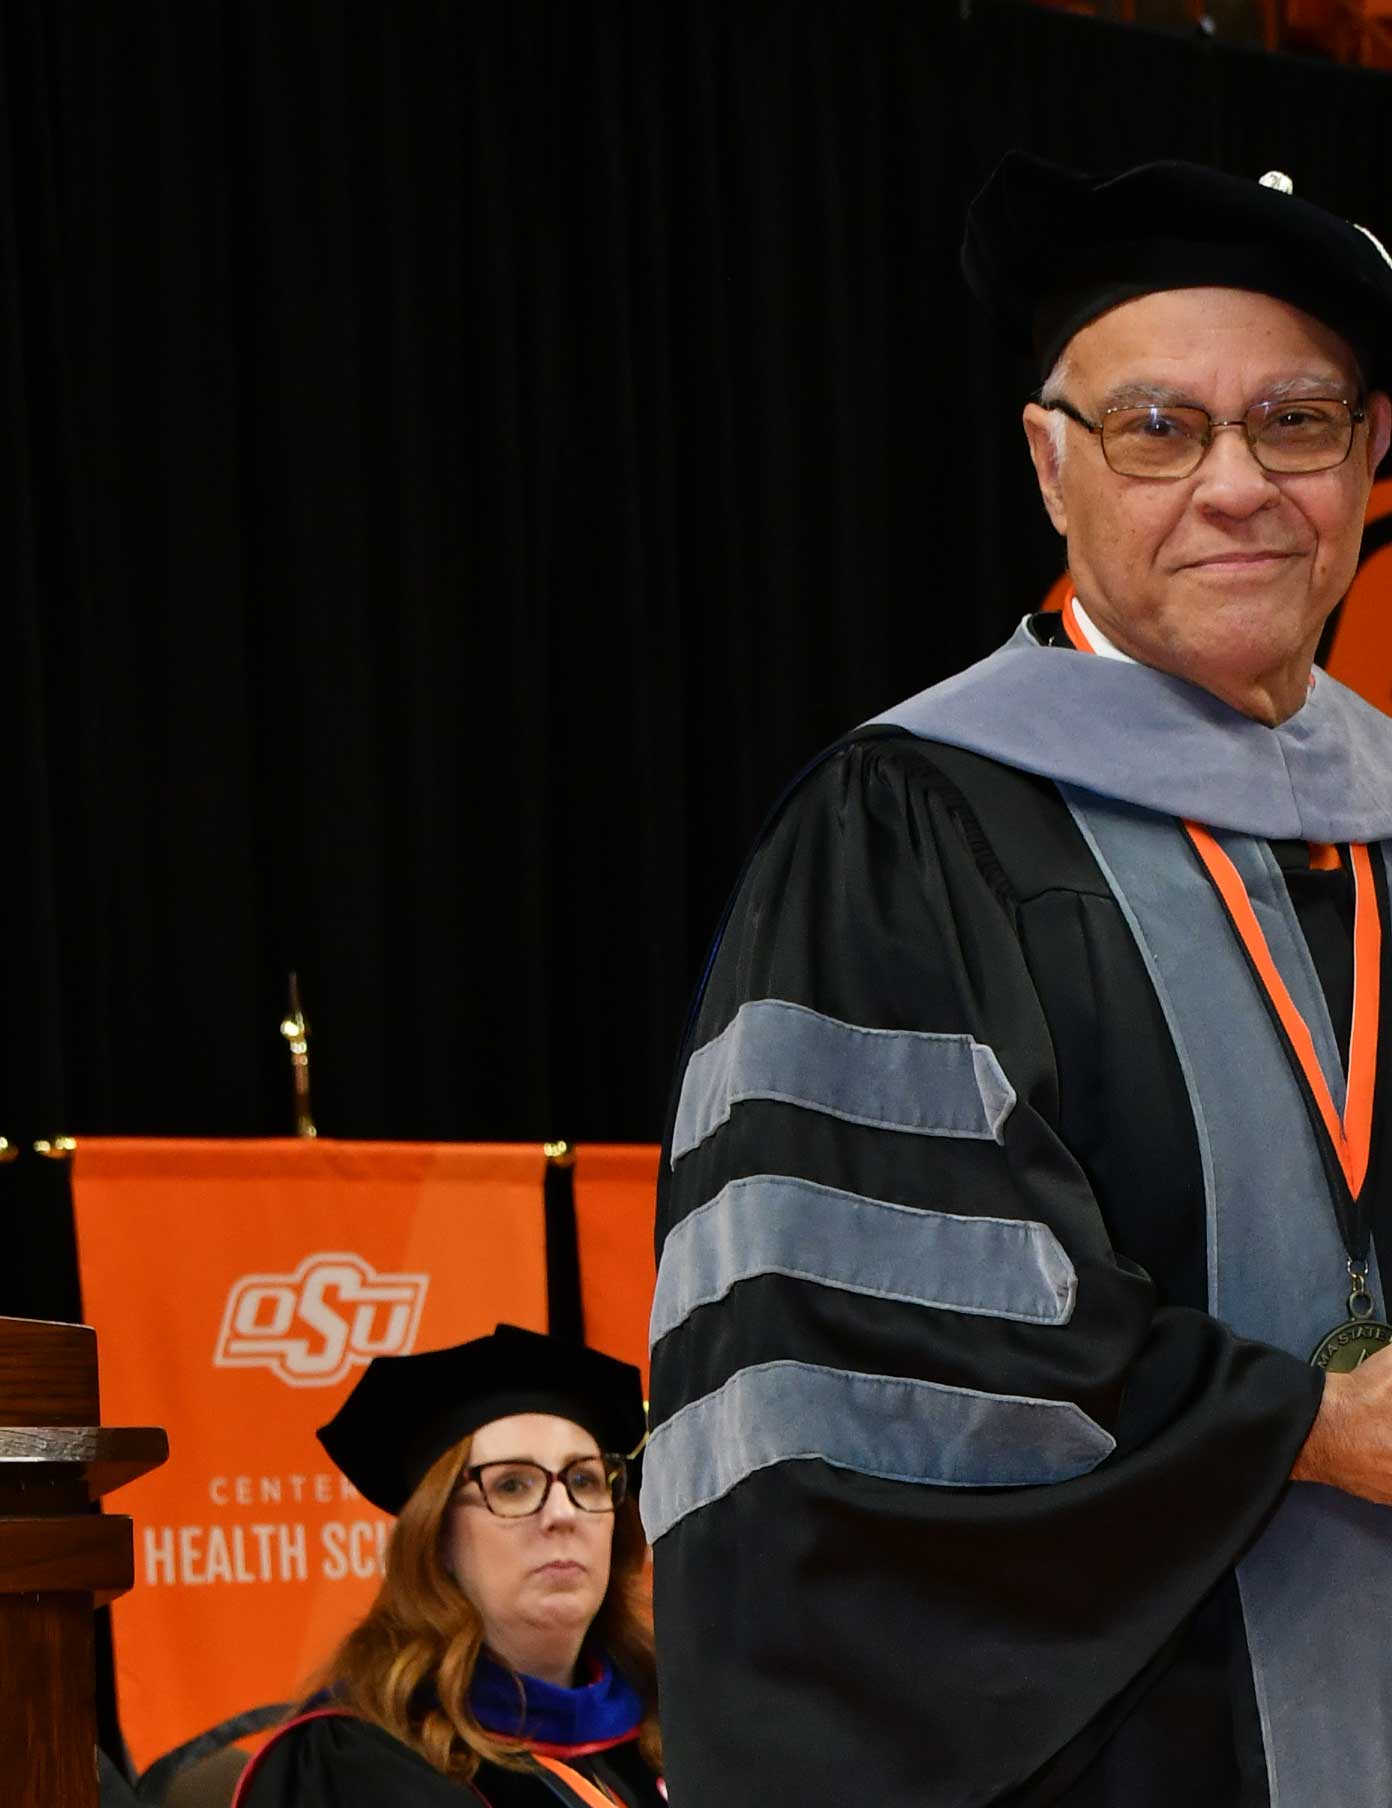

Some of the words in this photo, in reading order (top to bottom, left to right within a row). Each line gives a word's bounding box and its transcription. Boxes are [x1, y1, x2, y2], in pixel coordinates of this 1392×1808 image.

[226, 1262, 418, 1375] OSU
[1338, 1326, 1386, 1345] STATE
[143, 1522, 308, 1585] HEALTH
